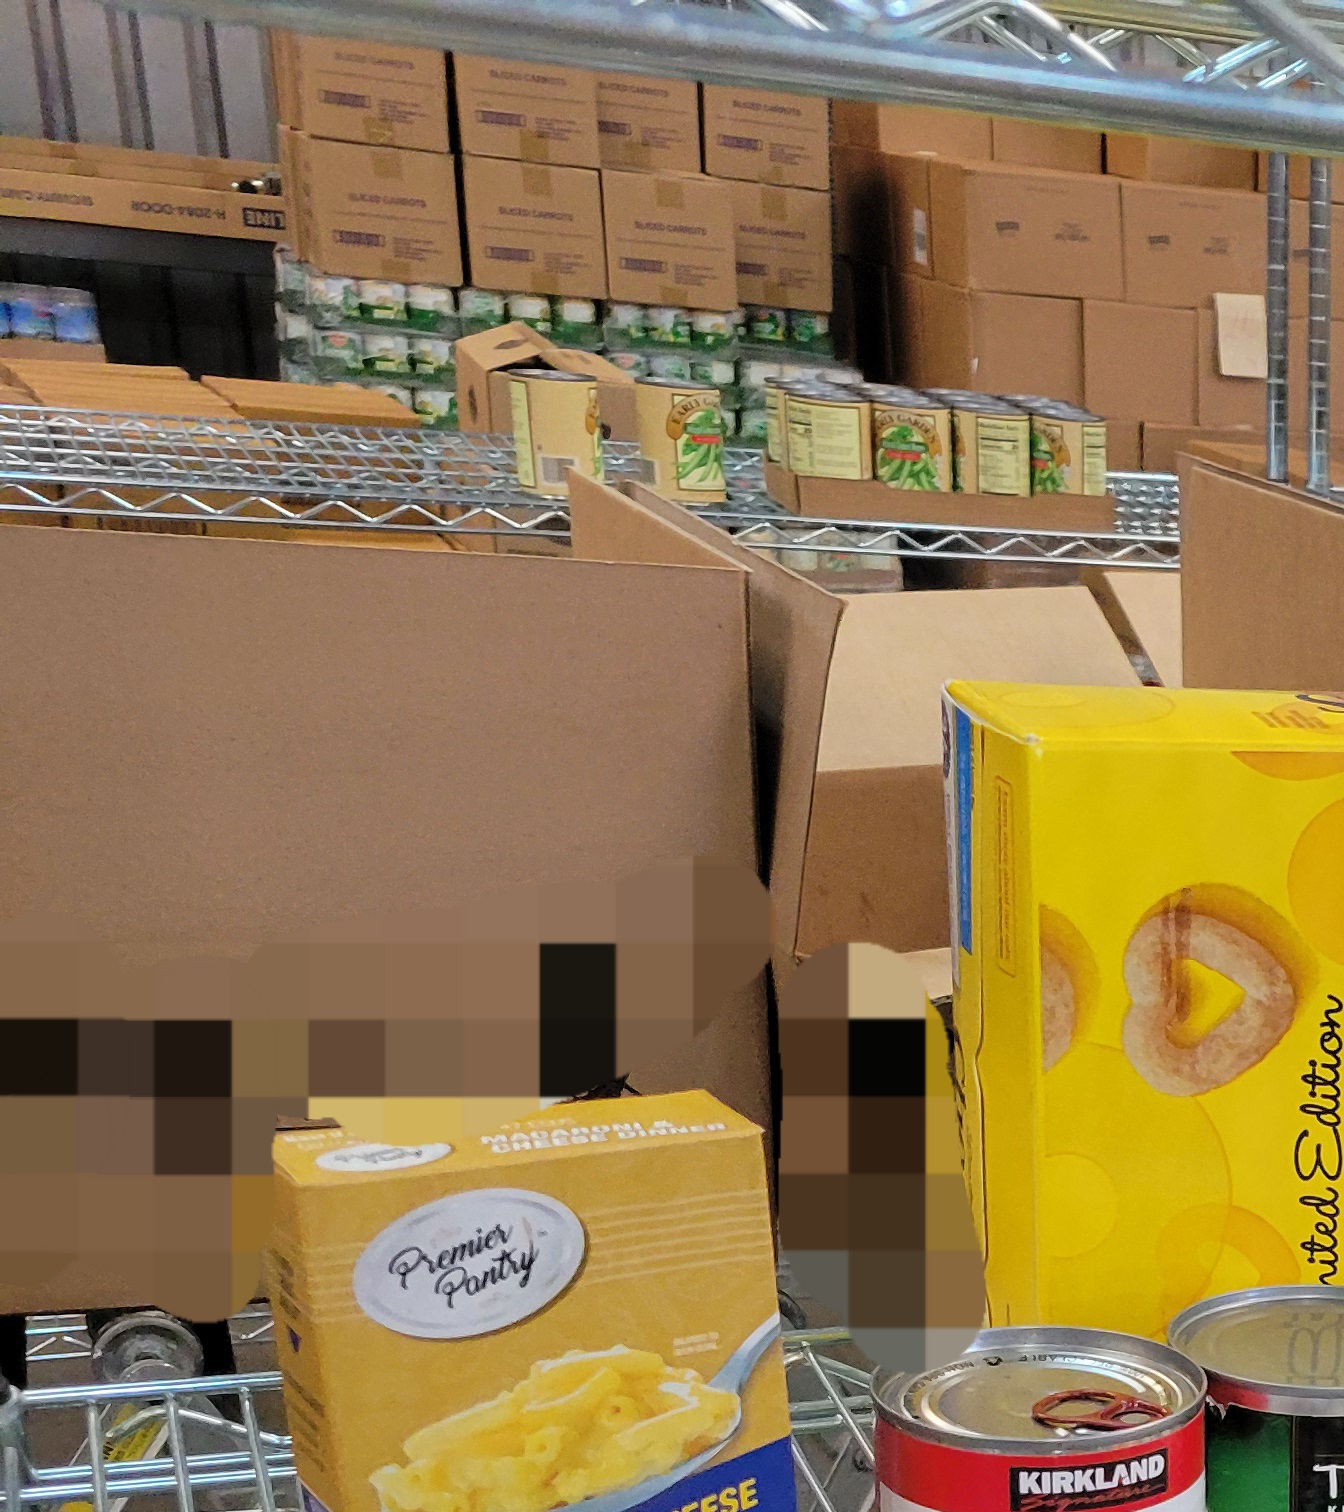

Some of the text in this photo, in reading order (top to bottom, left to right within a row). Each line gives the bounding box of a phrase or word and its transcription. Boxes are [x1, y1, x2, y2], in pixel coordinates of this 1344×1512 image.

[1295, 993, 1343, 1182] Edition
[389, 1223, 513, 1290] Premier
[435, 1245, 538, 1308] Pantry
[1019, 1455, 1164, 1494] KIRKLAND
